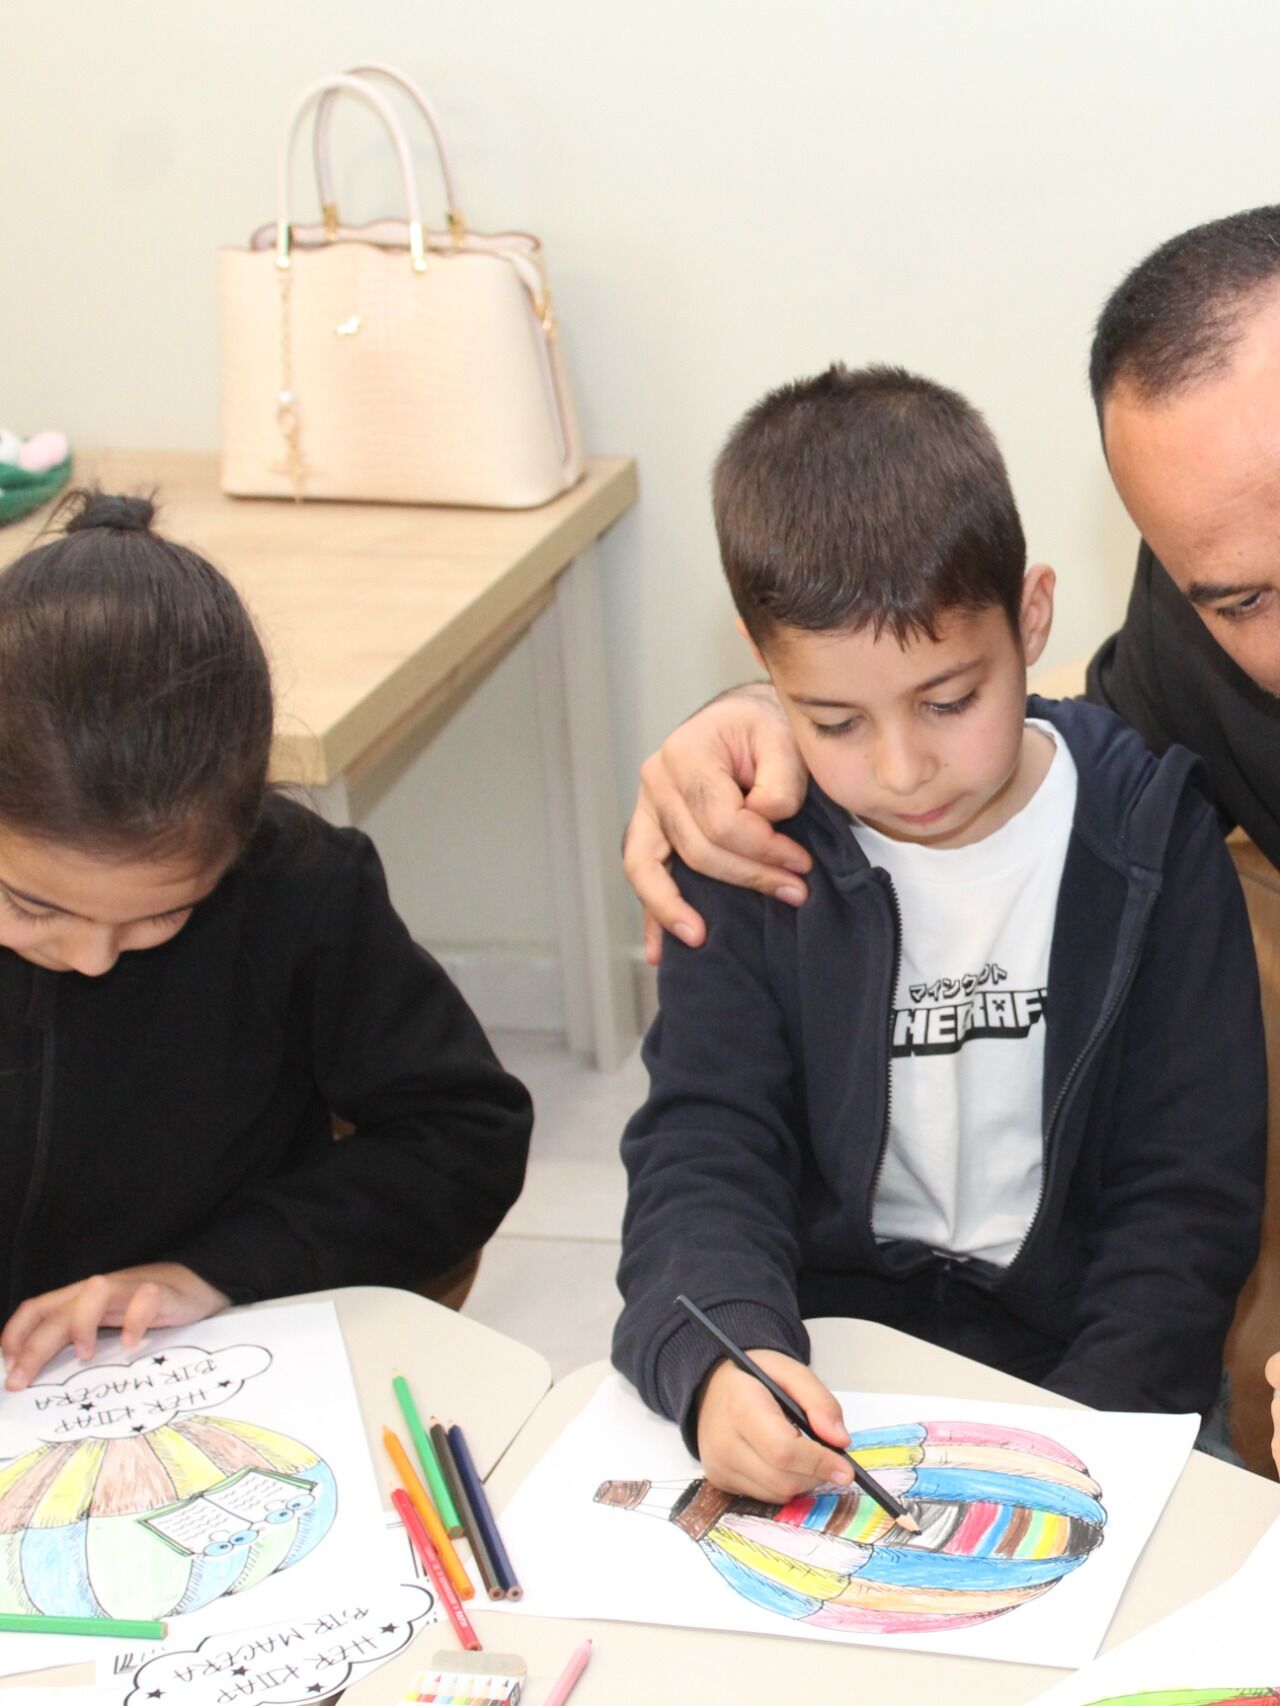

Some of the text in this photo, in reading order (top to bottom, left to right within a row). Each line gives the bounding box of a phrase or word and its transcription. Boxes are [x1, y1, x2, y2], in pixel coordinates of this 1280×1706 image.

[35, 1358, 217, 1410] BIR MACERA
[143, 1389, 207, 1415] HER
[172, 1627, 304, 1682] MACERA
[304, 1636, 378, 1670] HER
